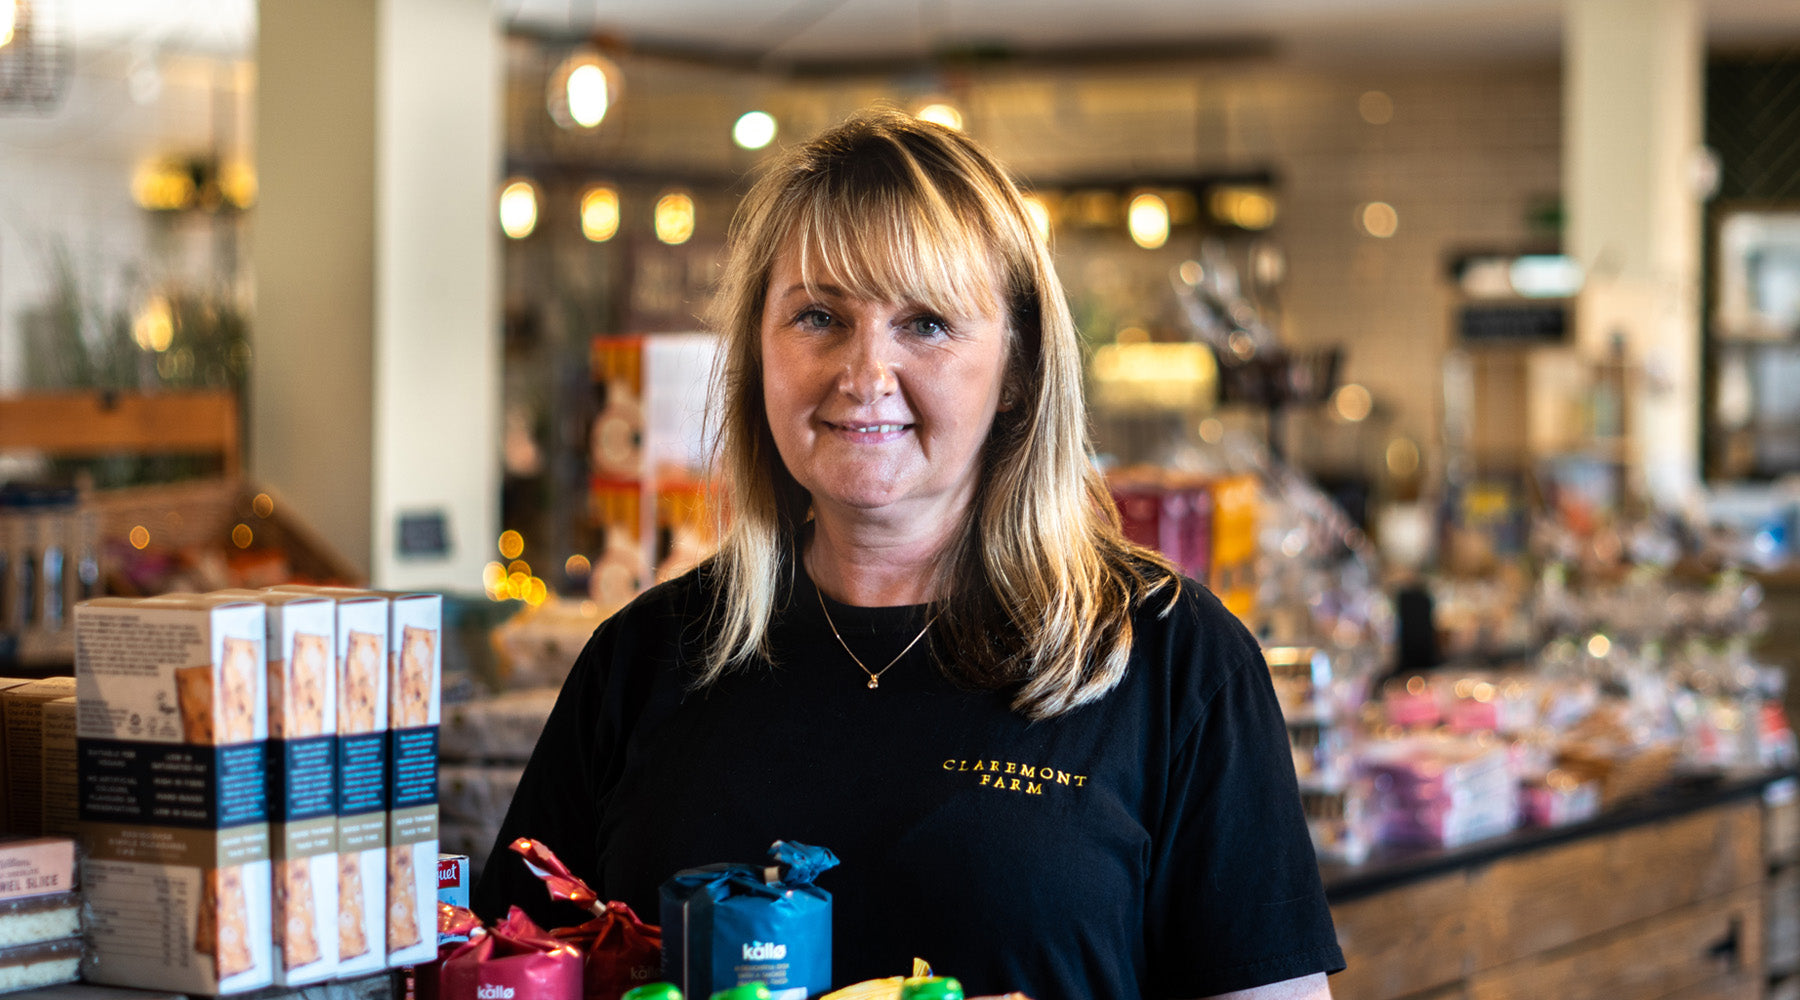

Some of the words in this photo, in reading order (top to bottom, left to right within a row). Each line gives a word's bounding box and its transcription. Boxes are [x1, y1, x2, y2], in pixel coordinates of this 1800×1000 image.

[942, 759, 1088, 787] CLAREMONT
[979, 774, 1043, 796] FARM
[437, 863, 457, 881] uet
